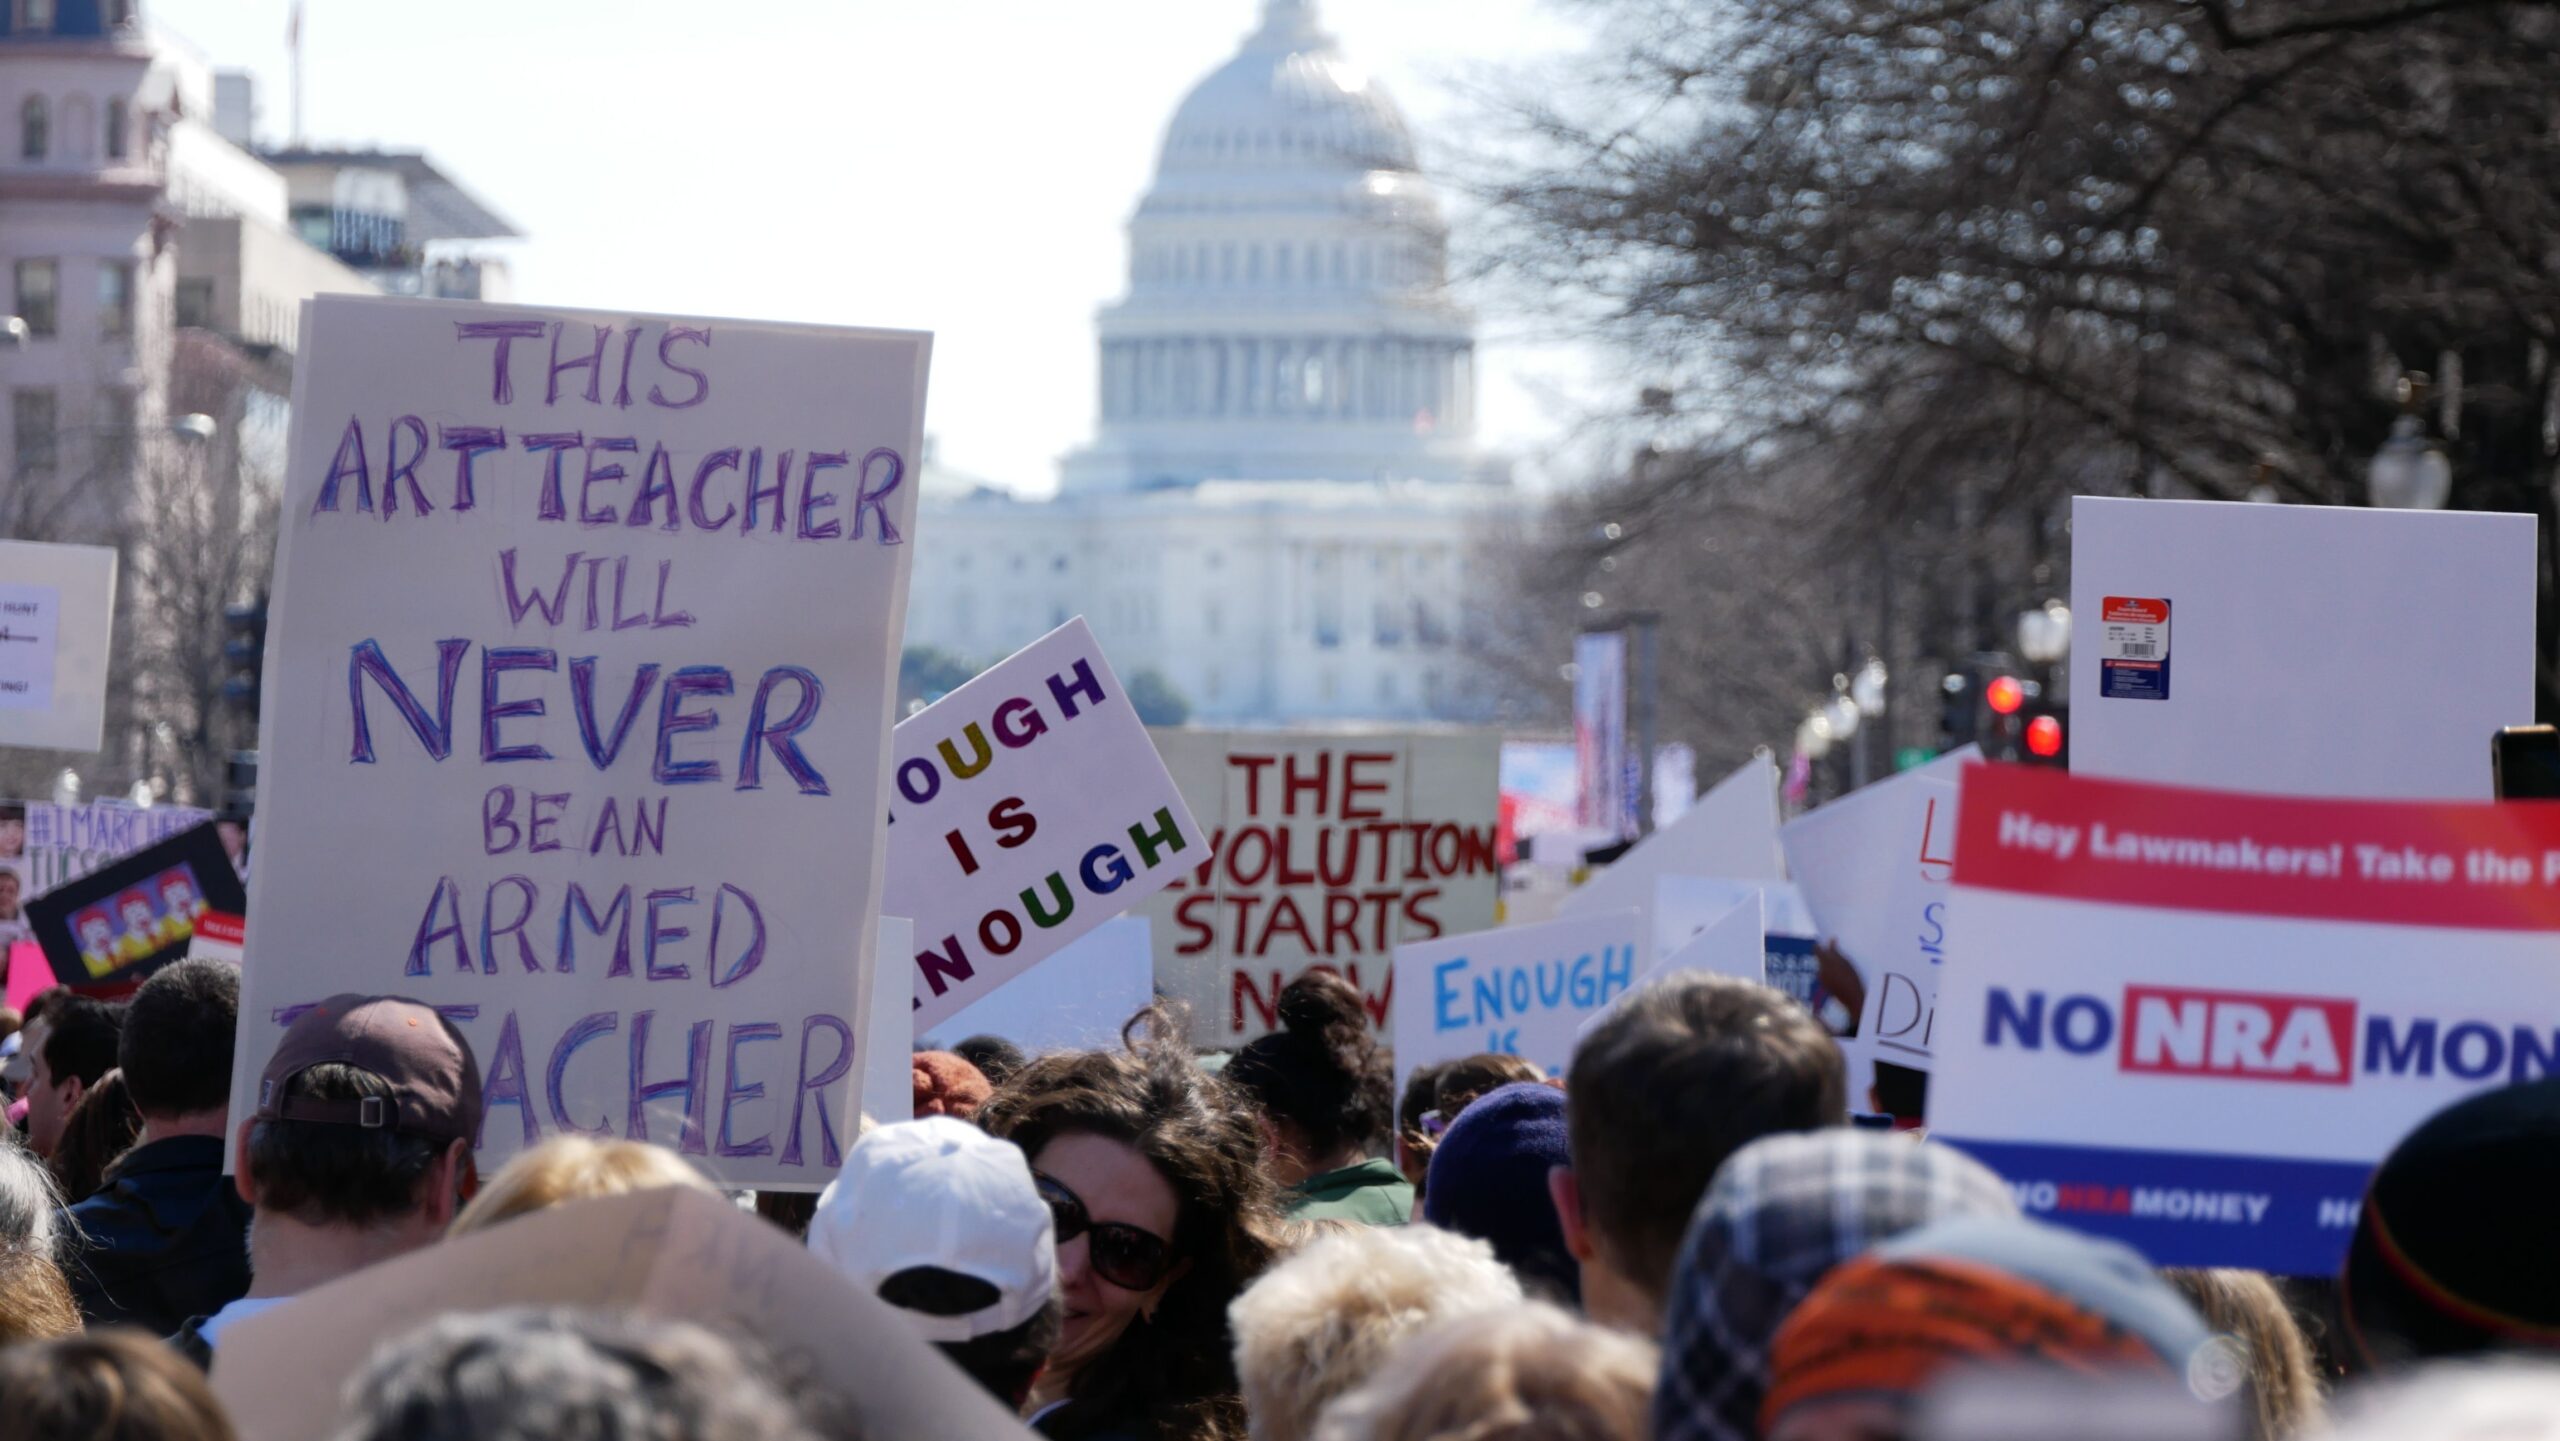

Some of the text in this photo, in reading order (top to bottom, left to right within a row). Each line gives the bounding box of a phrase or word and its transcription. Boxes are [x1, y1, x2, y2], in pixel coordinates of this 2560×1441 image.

[454, 321, 711, 409] THIS
[311, 414, 903, 545] ART TEACHER
[499, 547, 697, 631] WILL
[349, 637, 830, 795] NEVER
[888, 657, 1106, 827] OUGH
[482, 784, 668, 857] BE AN
[1227, 752, 1395, 820] THE
[945, 796, 1037, 876] IS
[1163, 819, 1497, 889] VOLUTION
[2000, 811, 2079, 858] Hey
[2090, 824, 2343, 878] Lawmakers!
[2354, 845, 2454, 882] Take
[2465, 848, 2532, 884] the
[404, 874, 767, 988] ARMED
[913, 806, 1187, 1012] NOUGH
[1175, 888, 1442, 956] STARTS
[1232, 961, 1394, 1033] NW
[1434, 944, 1634, 1032] ENOUGH
[2133, 996, 2342, 1076] NRA
[272, 1003, 855, 1167] ACHER
